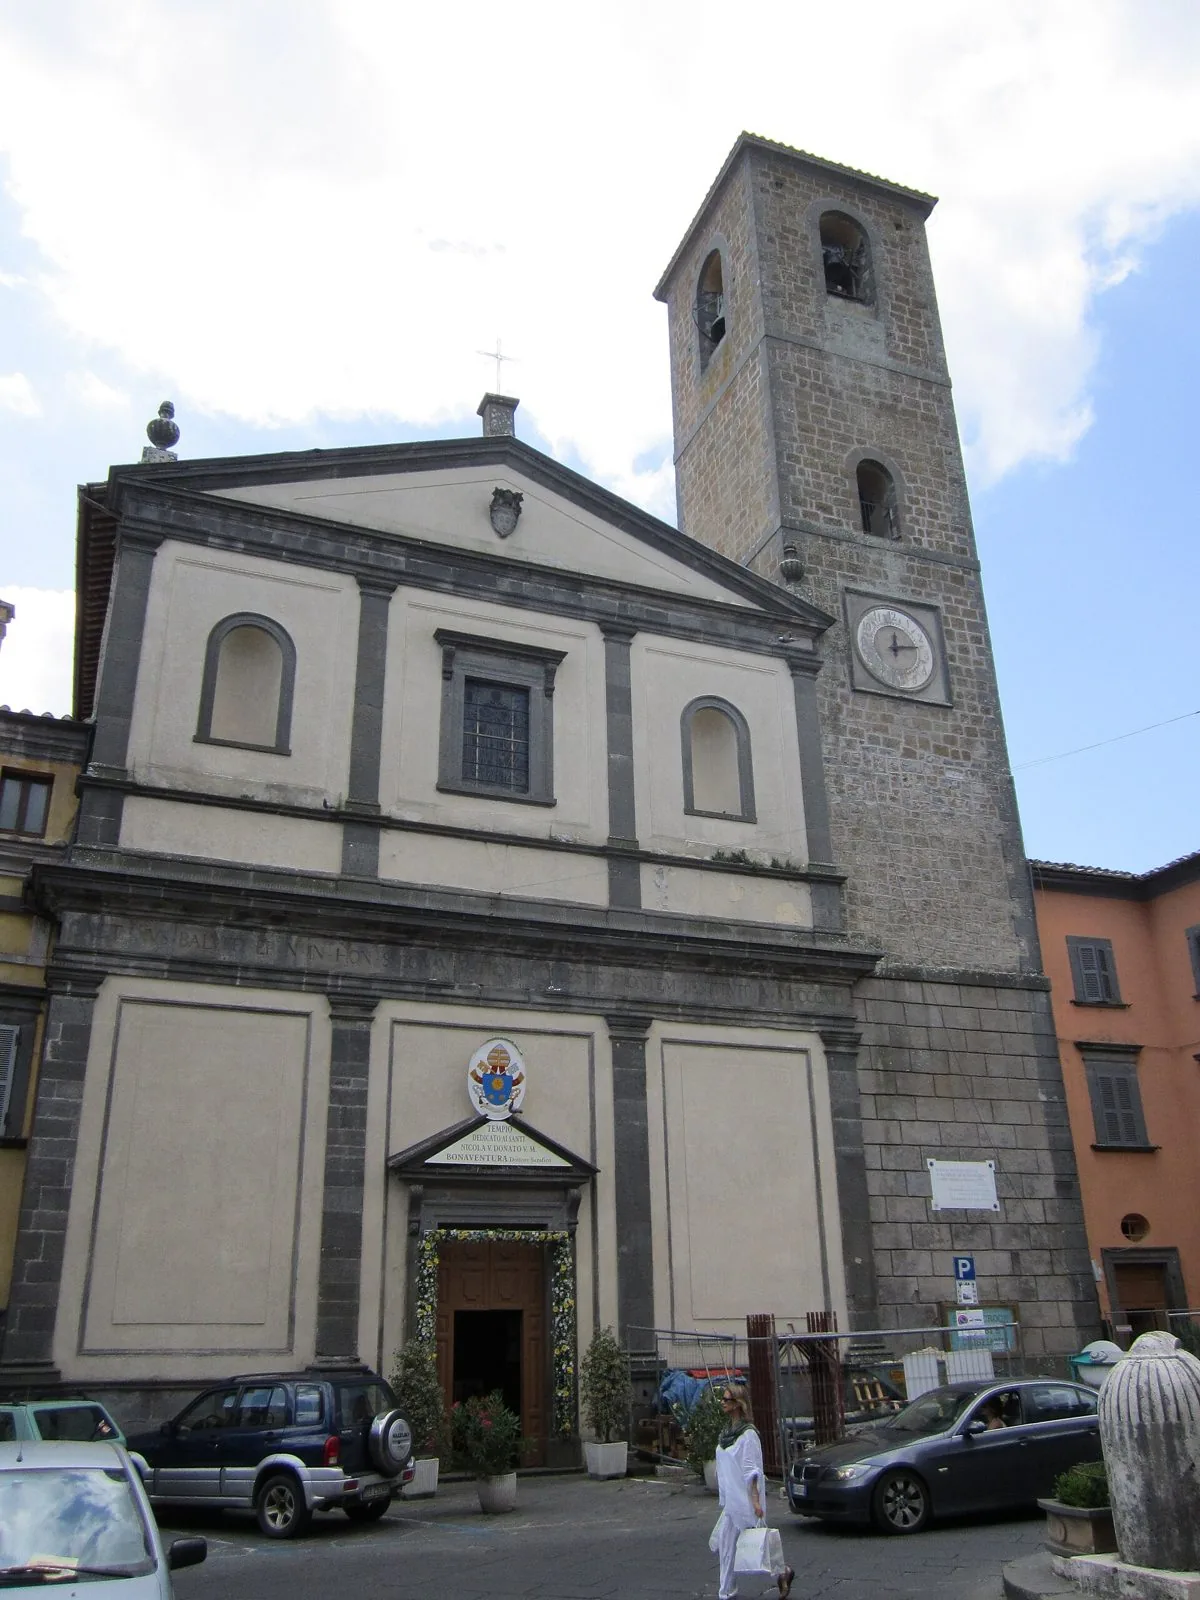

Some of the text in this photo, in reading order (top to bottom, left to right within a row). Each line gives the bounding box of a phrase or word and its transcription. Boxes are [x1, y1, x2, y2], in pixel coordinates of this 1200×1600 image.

[487, 1124, 513, 1133] TEMPIO
[472, 1134, 500, 1142] DEDICATO
[507, 1135, 525, 1143] SANTI
[460, 1144, 486, 1152] NICOLA
[493, 1145, 521, 1153] DONATO
[446, 1153, 508, 1162] BONAVENTURA
[958, 1259, 971, 1278] P
